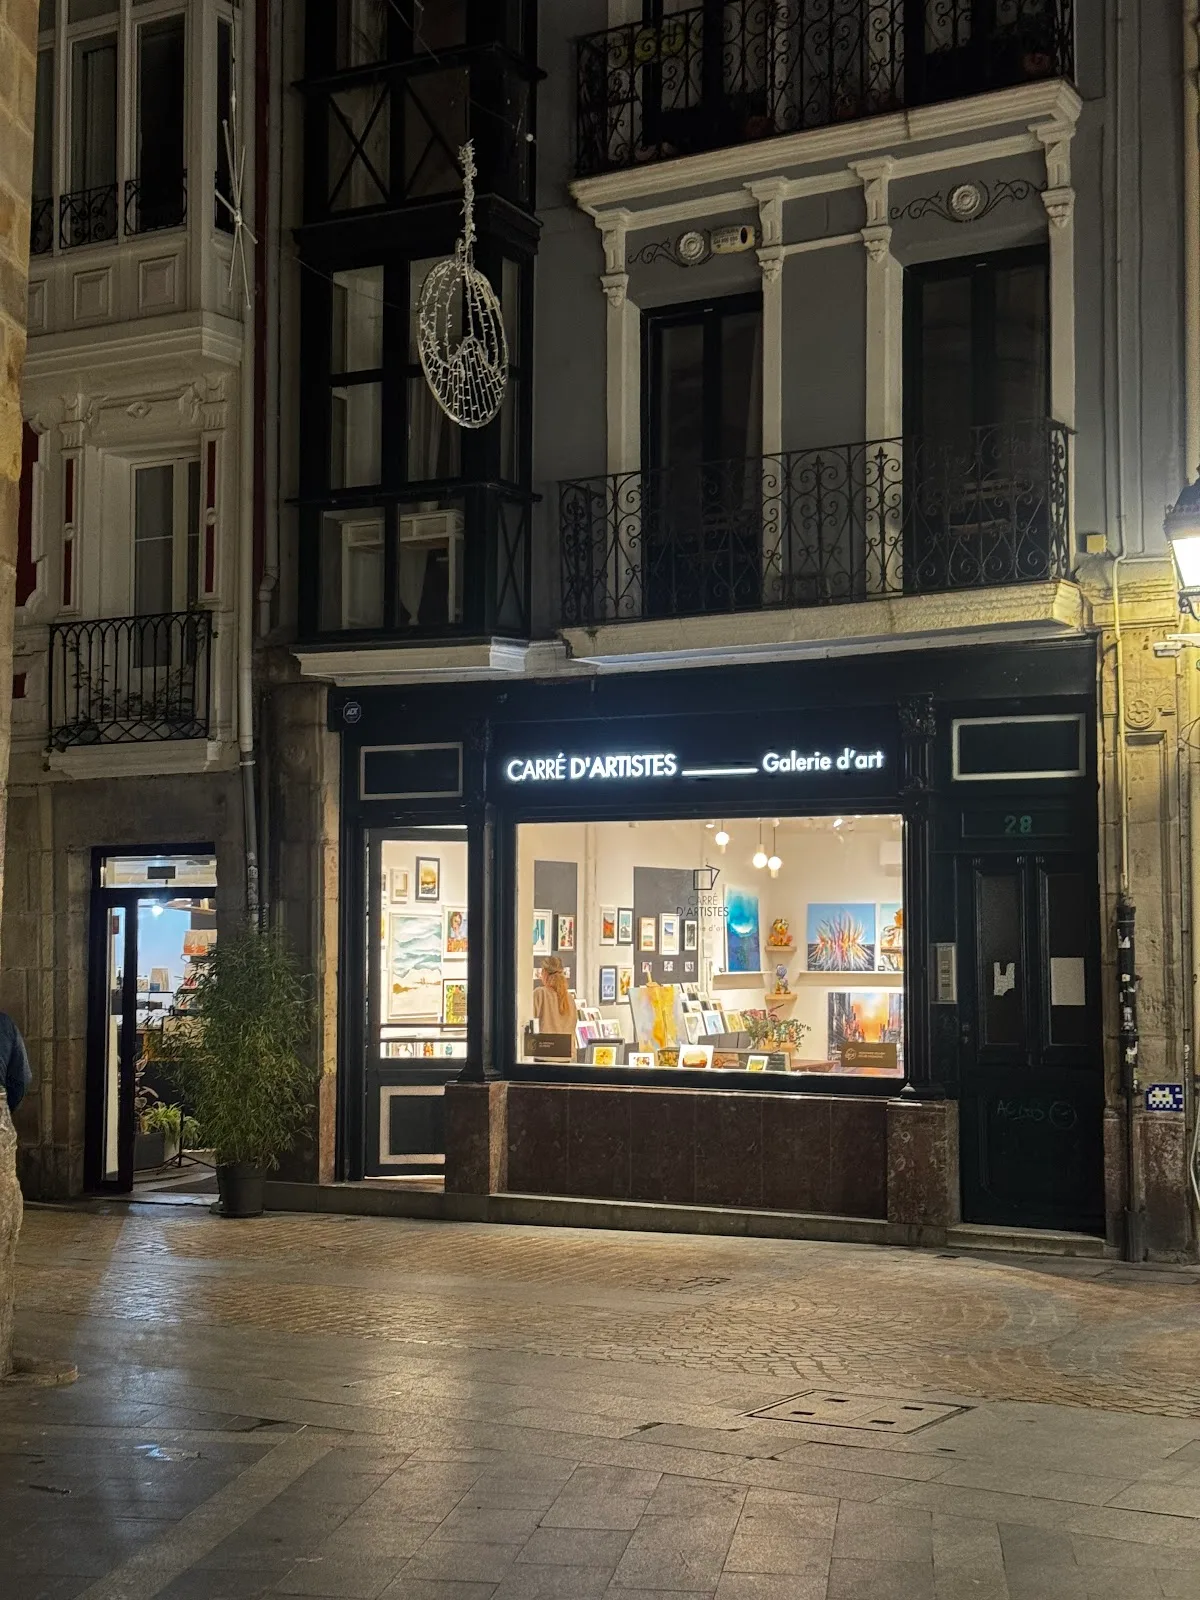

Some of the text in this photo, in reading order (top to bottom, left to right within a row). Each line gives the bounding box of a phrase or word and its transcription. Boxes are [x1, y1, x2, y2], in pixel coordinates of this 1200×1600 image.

[507, 752, 677, 781] CARRÉ D'ARTISTES
[762, 747, 884, 772] Galerie d'art
[1004, 815, 1033, 834] 28
[687, 892, 718, 906] CARRÉ
[676, 907, 729, 917] D'ARTISTES
